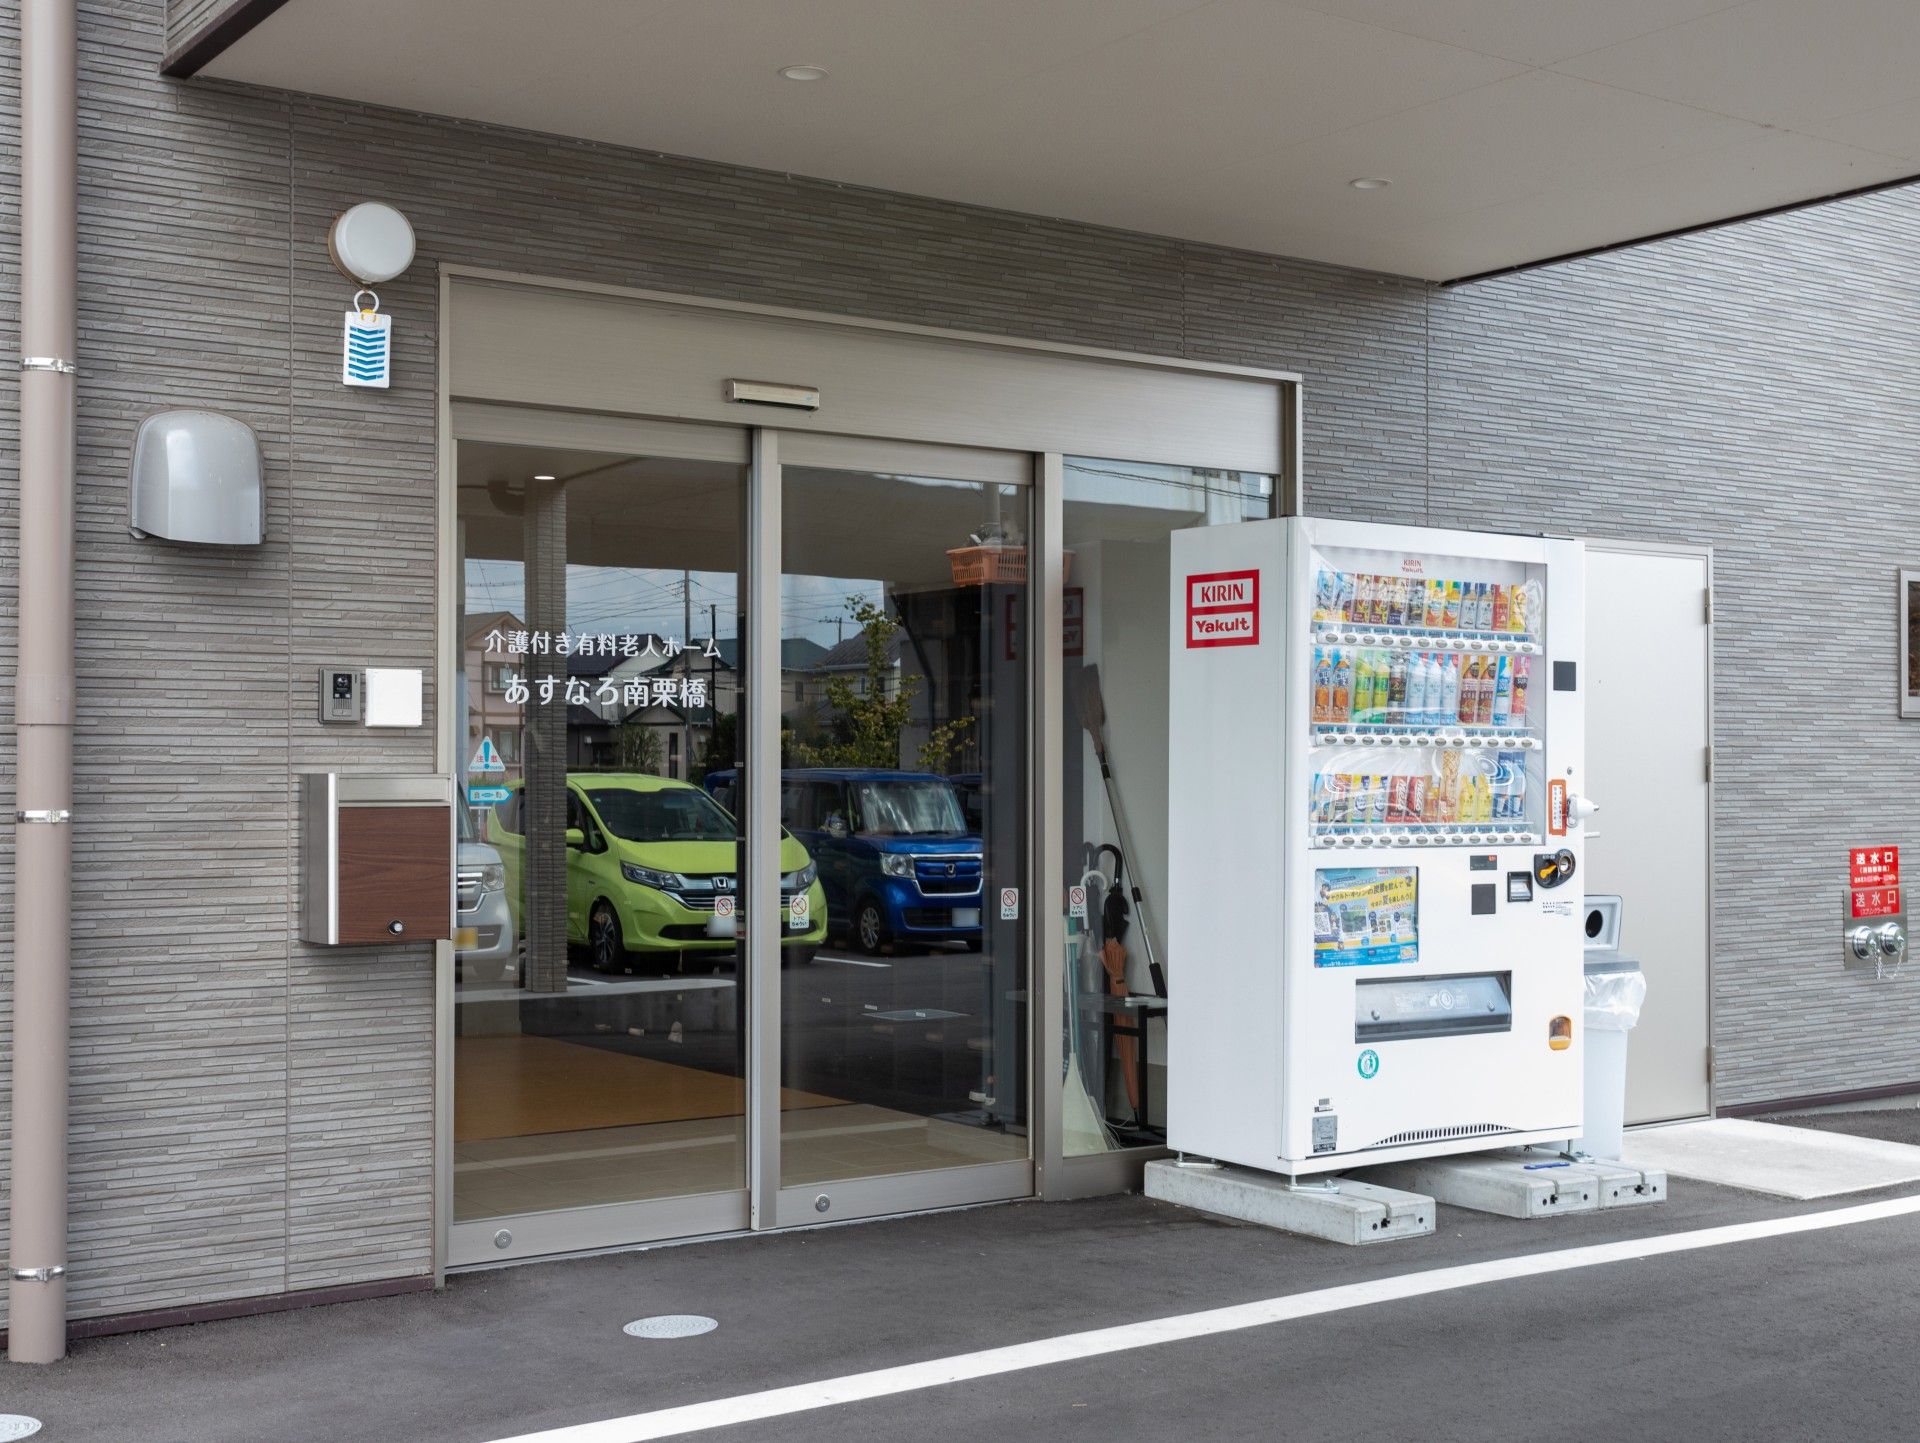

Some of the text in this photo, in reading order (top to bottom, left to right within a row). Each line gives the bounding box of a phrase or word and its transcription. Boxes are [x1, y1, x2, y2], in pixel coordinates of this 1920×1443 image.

[1403, 559, 1422, 567] KIRIN
[1201, 583, 1243, 603] KIRIN
[1195, 617, 1250, 633] Yakult
[485, 629, 722, 658] 介護付き有料老人ホーム
[504, 673, 706, 708] あすなろ南栗橋
[1856, 851, 1893, 865] 送水口
[1856, 890, 1896, 907] 送水口
